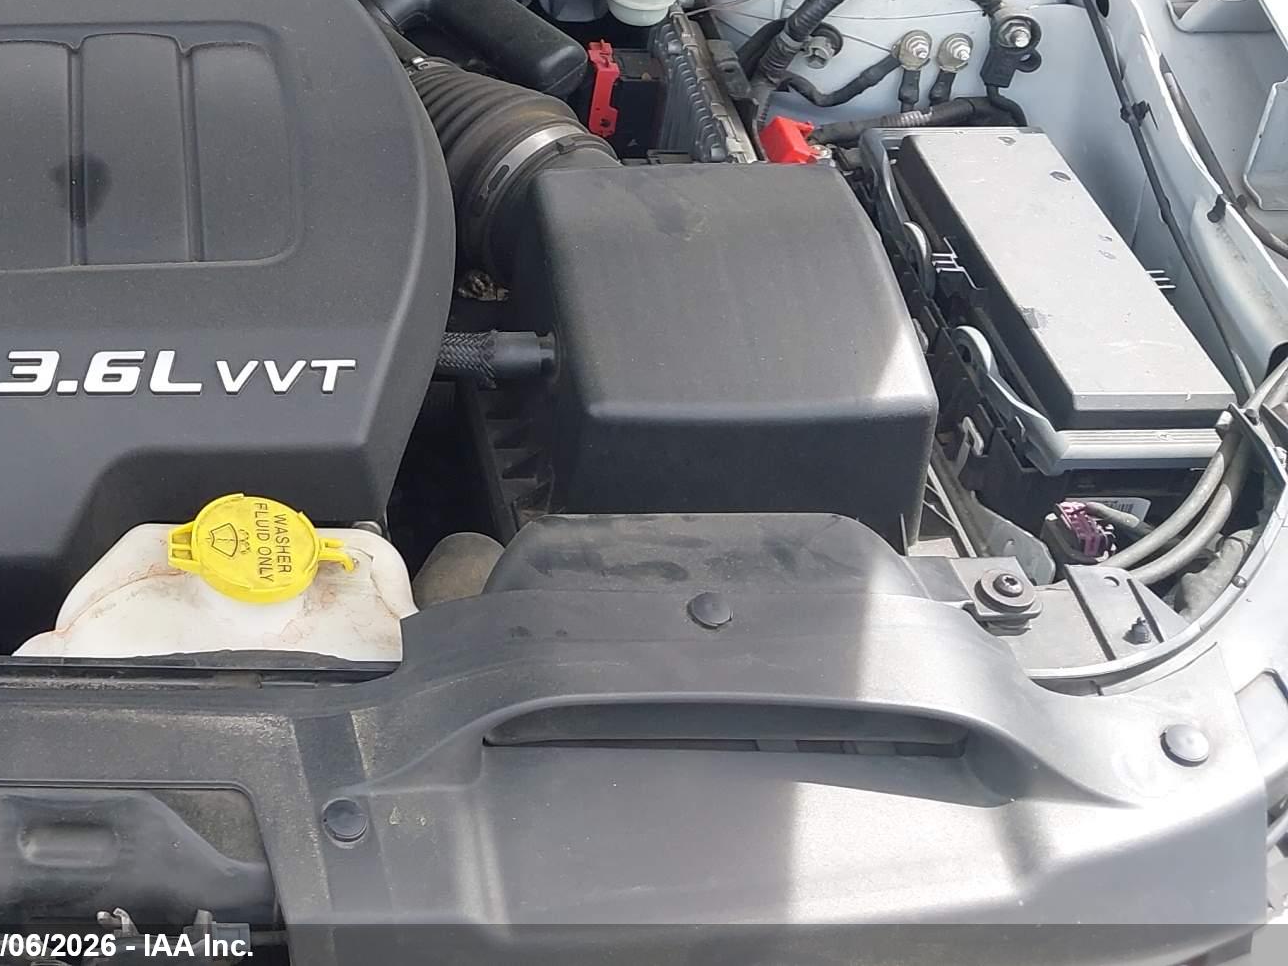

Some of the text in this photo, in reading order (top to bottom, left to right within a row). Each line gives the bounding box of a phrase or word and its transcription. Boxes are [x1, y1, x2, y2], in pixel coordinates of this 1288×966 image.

[215, 359, 357, 395] VVT
[253, 502, 275, 583] FLUID ONLY
[273, 513, 293, 574] WASHER
